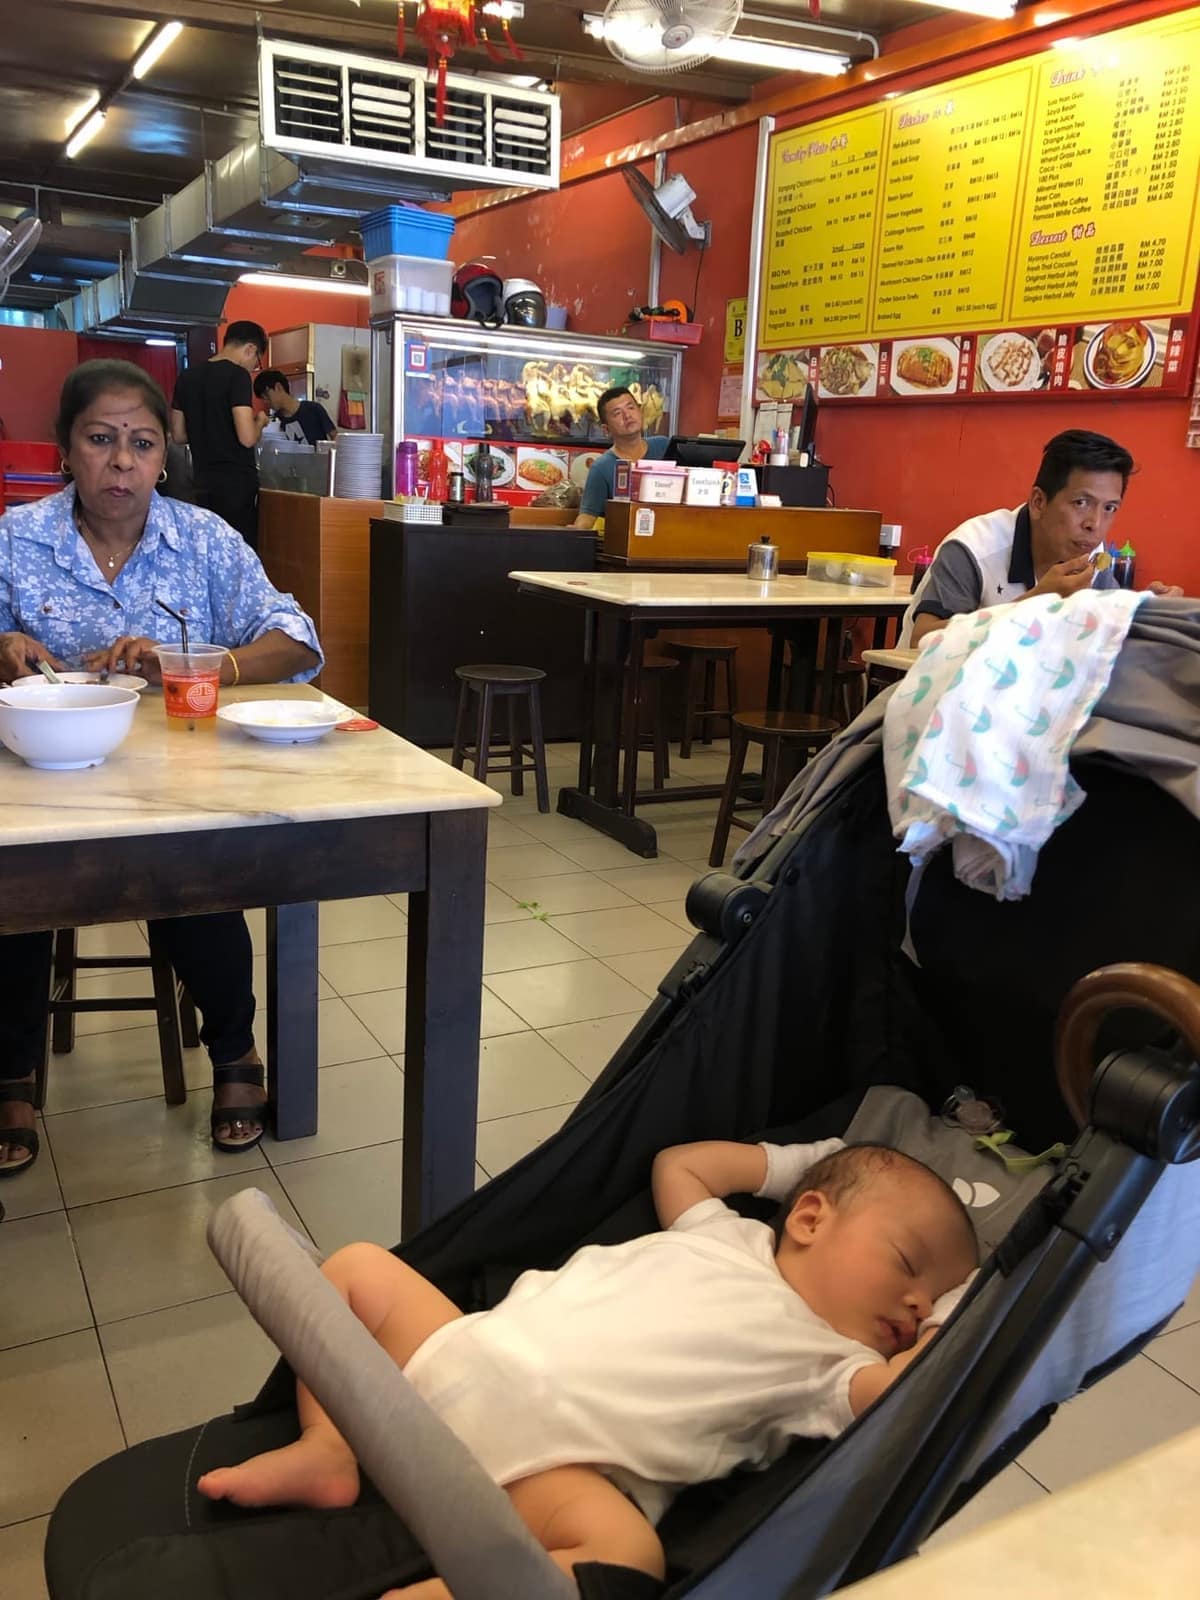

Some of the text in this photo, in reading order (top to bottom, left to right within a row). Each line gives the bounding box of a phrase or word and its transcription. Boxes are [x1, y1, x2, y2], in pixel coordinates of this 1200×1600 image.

[797, 202, 816, 212] Chicken
[793, 225, 813, 235] Chicken
[1029, 230, 1068, 247] Dessert
[1151, 247, 1166, 257] 7.00
[1149, 258, 1164, 267] 7.00
[1147, 269, 1162, 280] 7.00
[1145, 281, 1160, 291] 7.00
